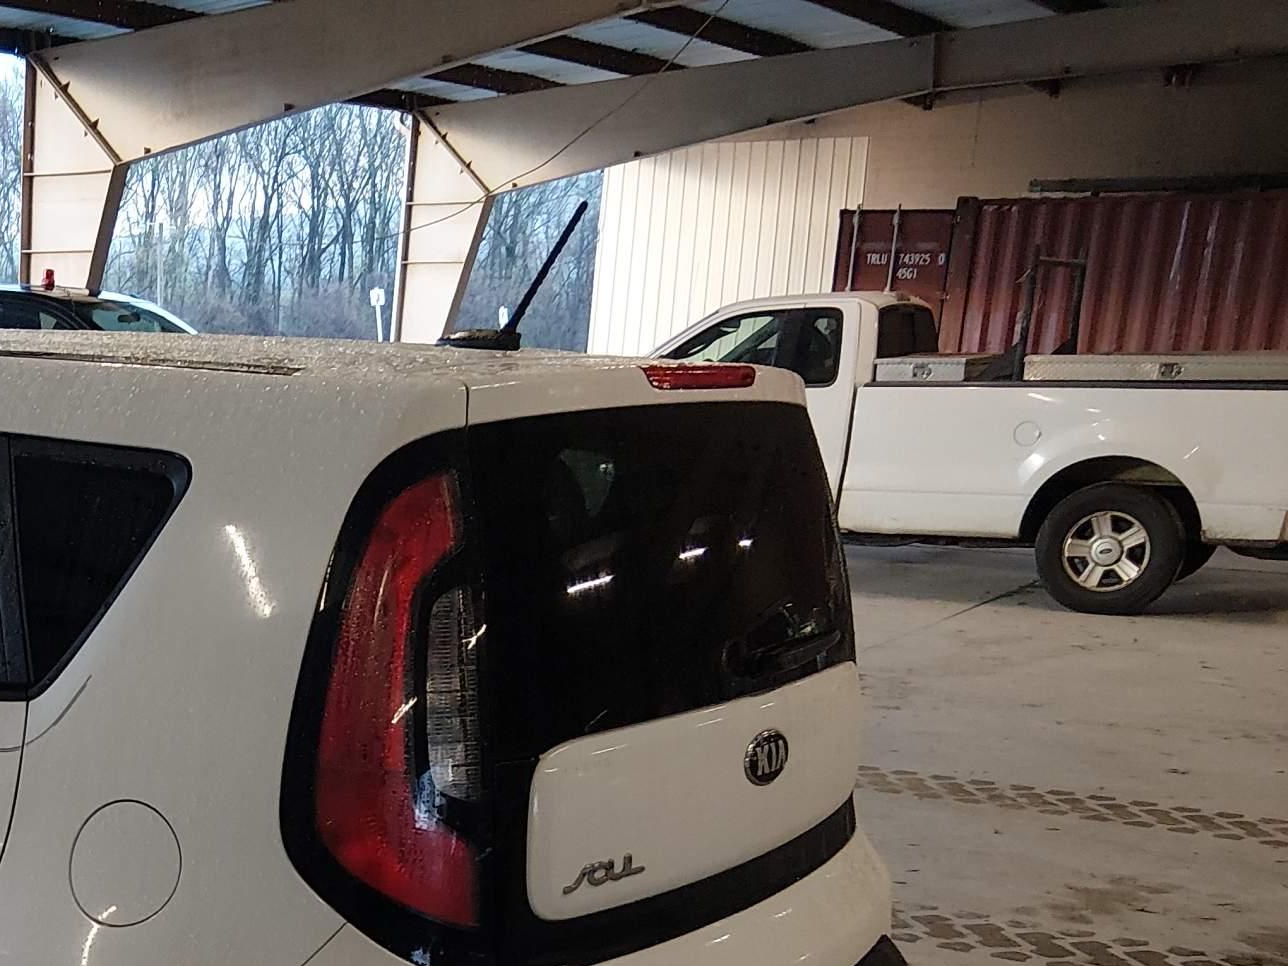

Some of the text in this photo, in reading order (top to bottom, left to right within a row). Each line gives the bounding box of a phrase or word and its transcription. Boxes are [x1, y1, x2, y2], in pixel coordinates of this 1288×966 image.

[866, 253, 888, 265] TRLU
[898, 253, 931, 265] 743925
[896, 268, 918, 280] 45G1
